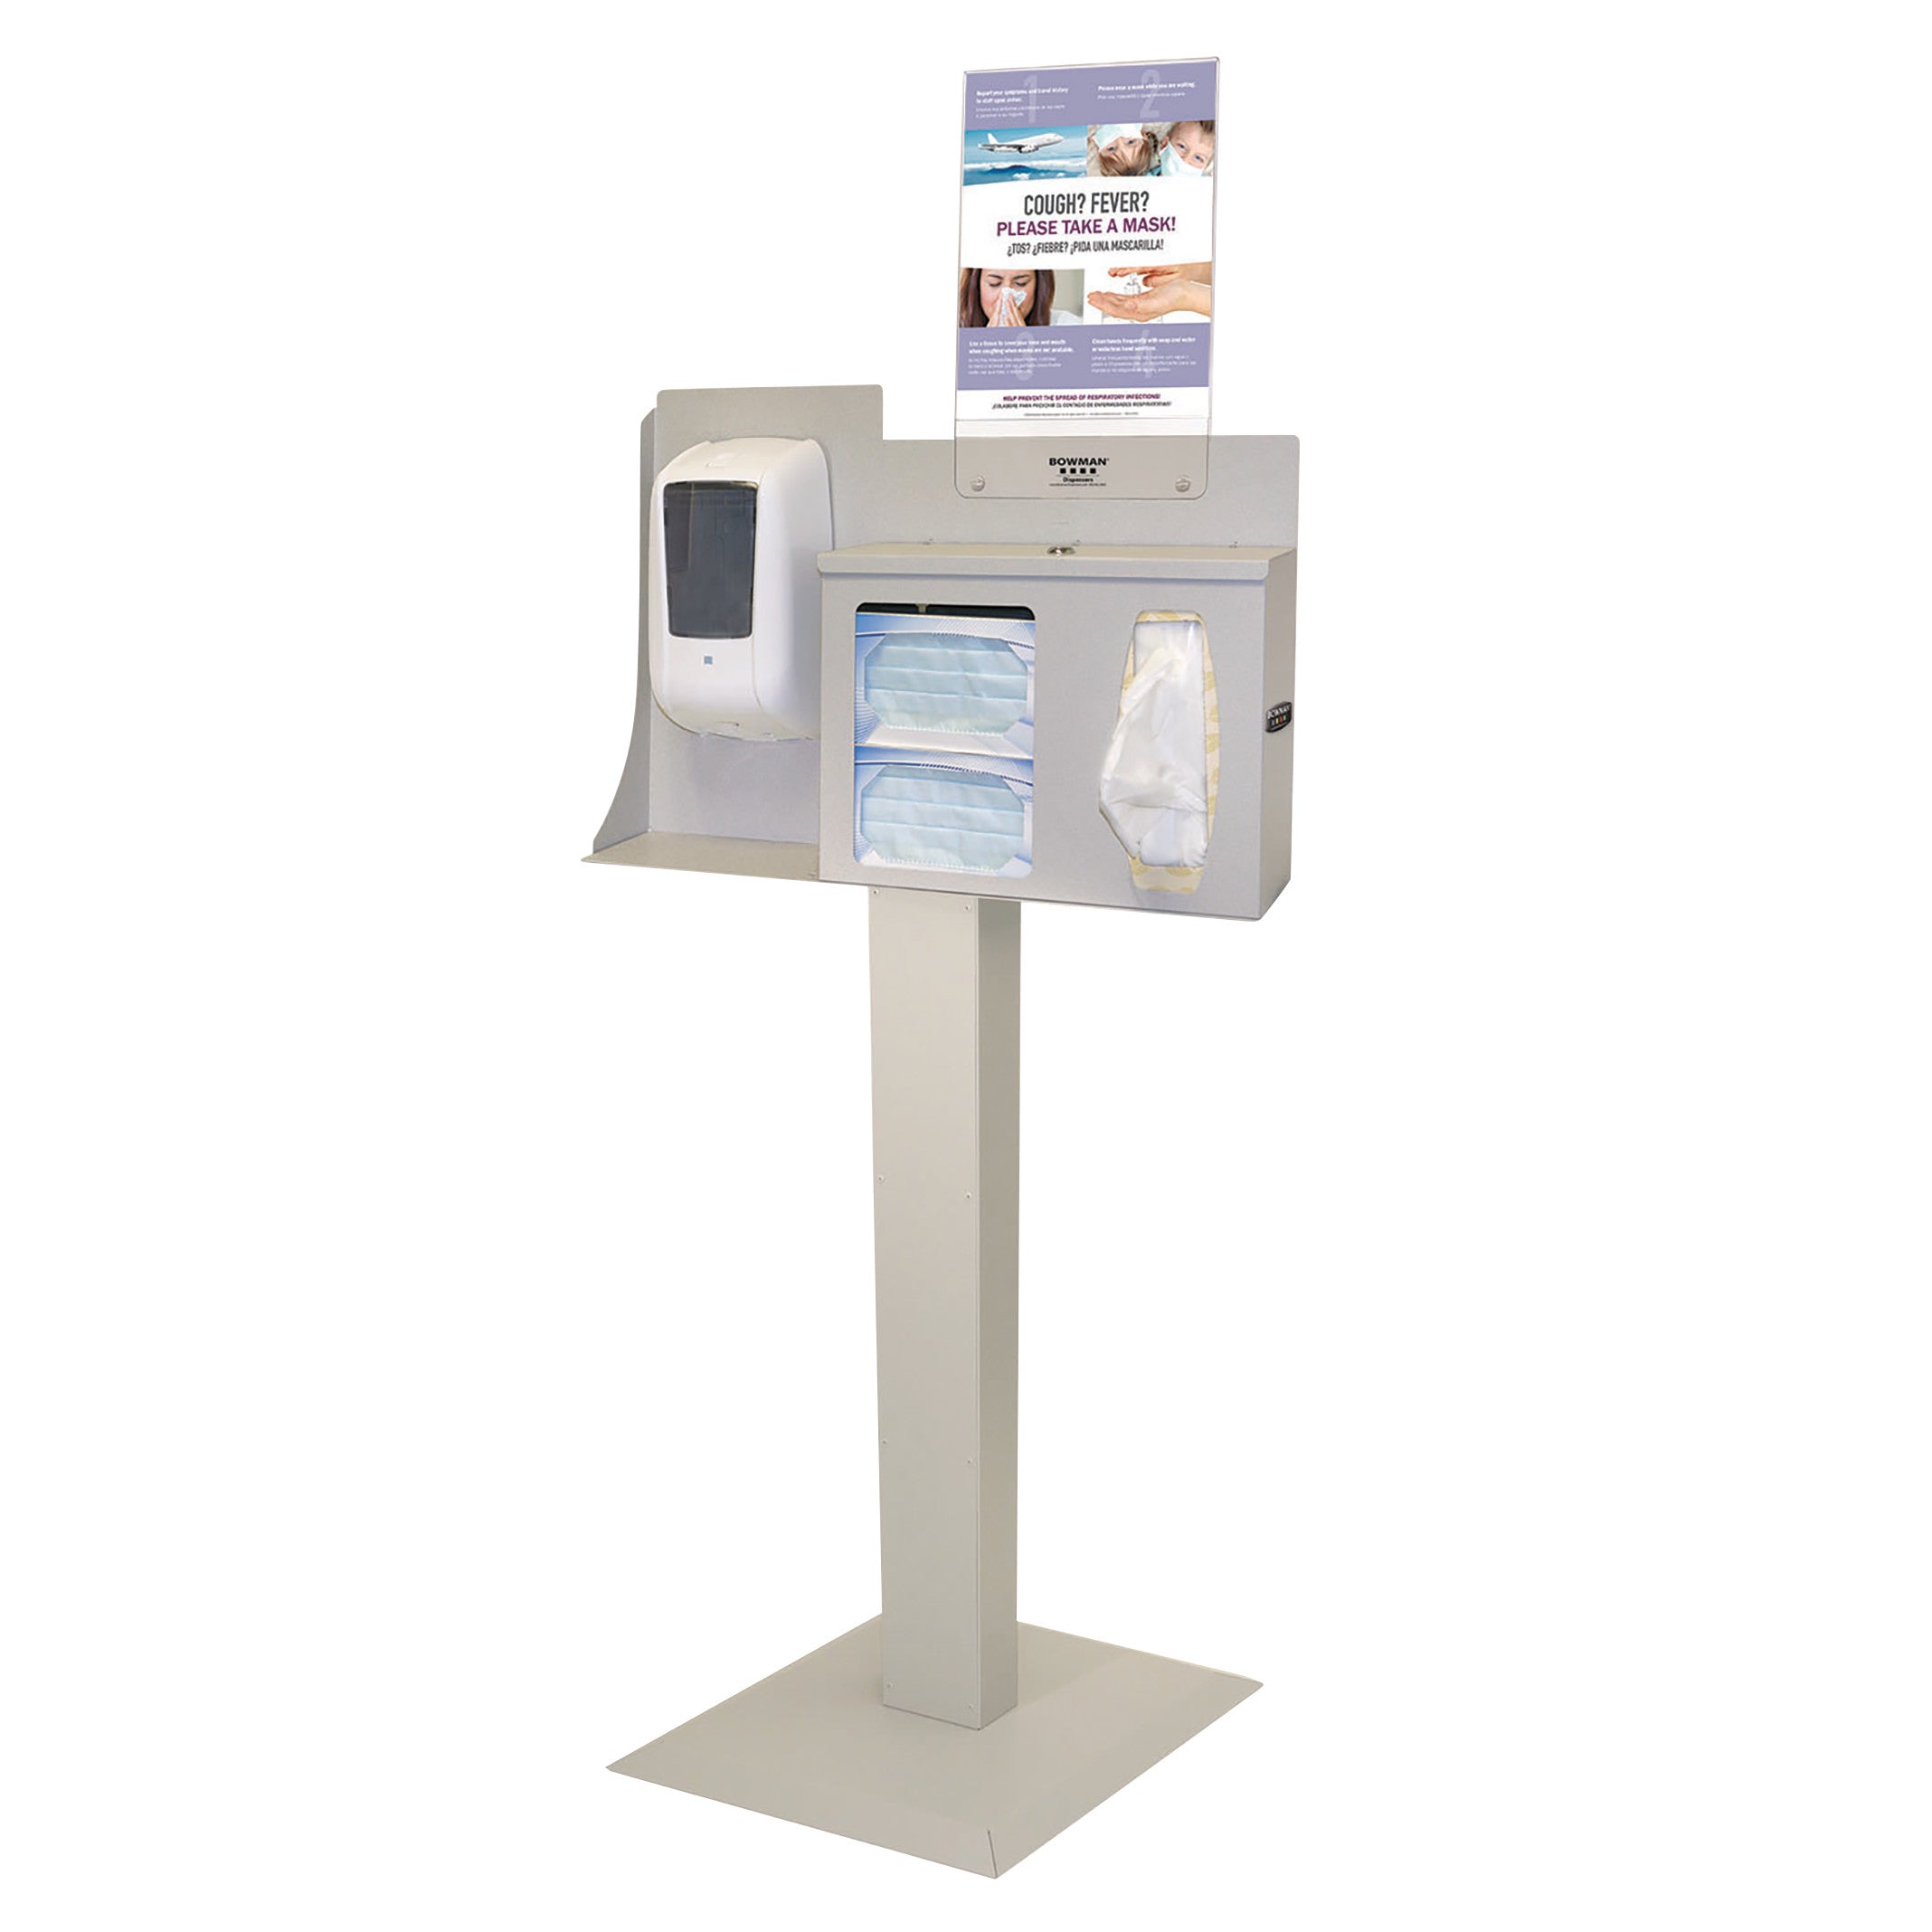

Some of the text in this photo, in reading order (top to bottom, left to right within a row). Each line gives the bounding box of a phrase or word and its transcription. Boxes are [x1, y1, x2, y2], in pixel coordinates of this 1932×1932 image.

[1024, 191, 1150, 216] COUGH? FEVER?
[997, 216, 1176, 237] PLEASE TAKE A MASK!
[1007, 239, 1164, 257] ¿TOS? ¿FIEBRE? ¡PIDA UNA MASCARILLA!
